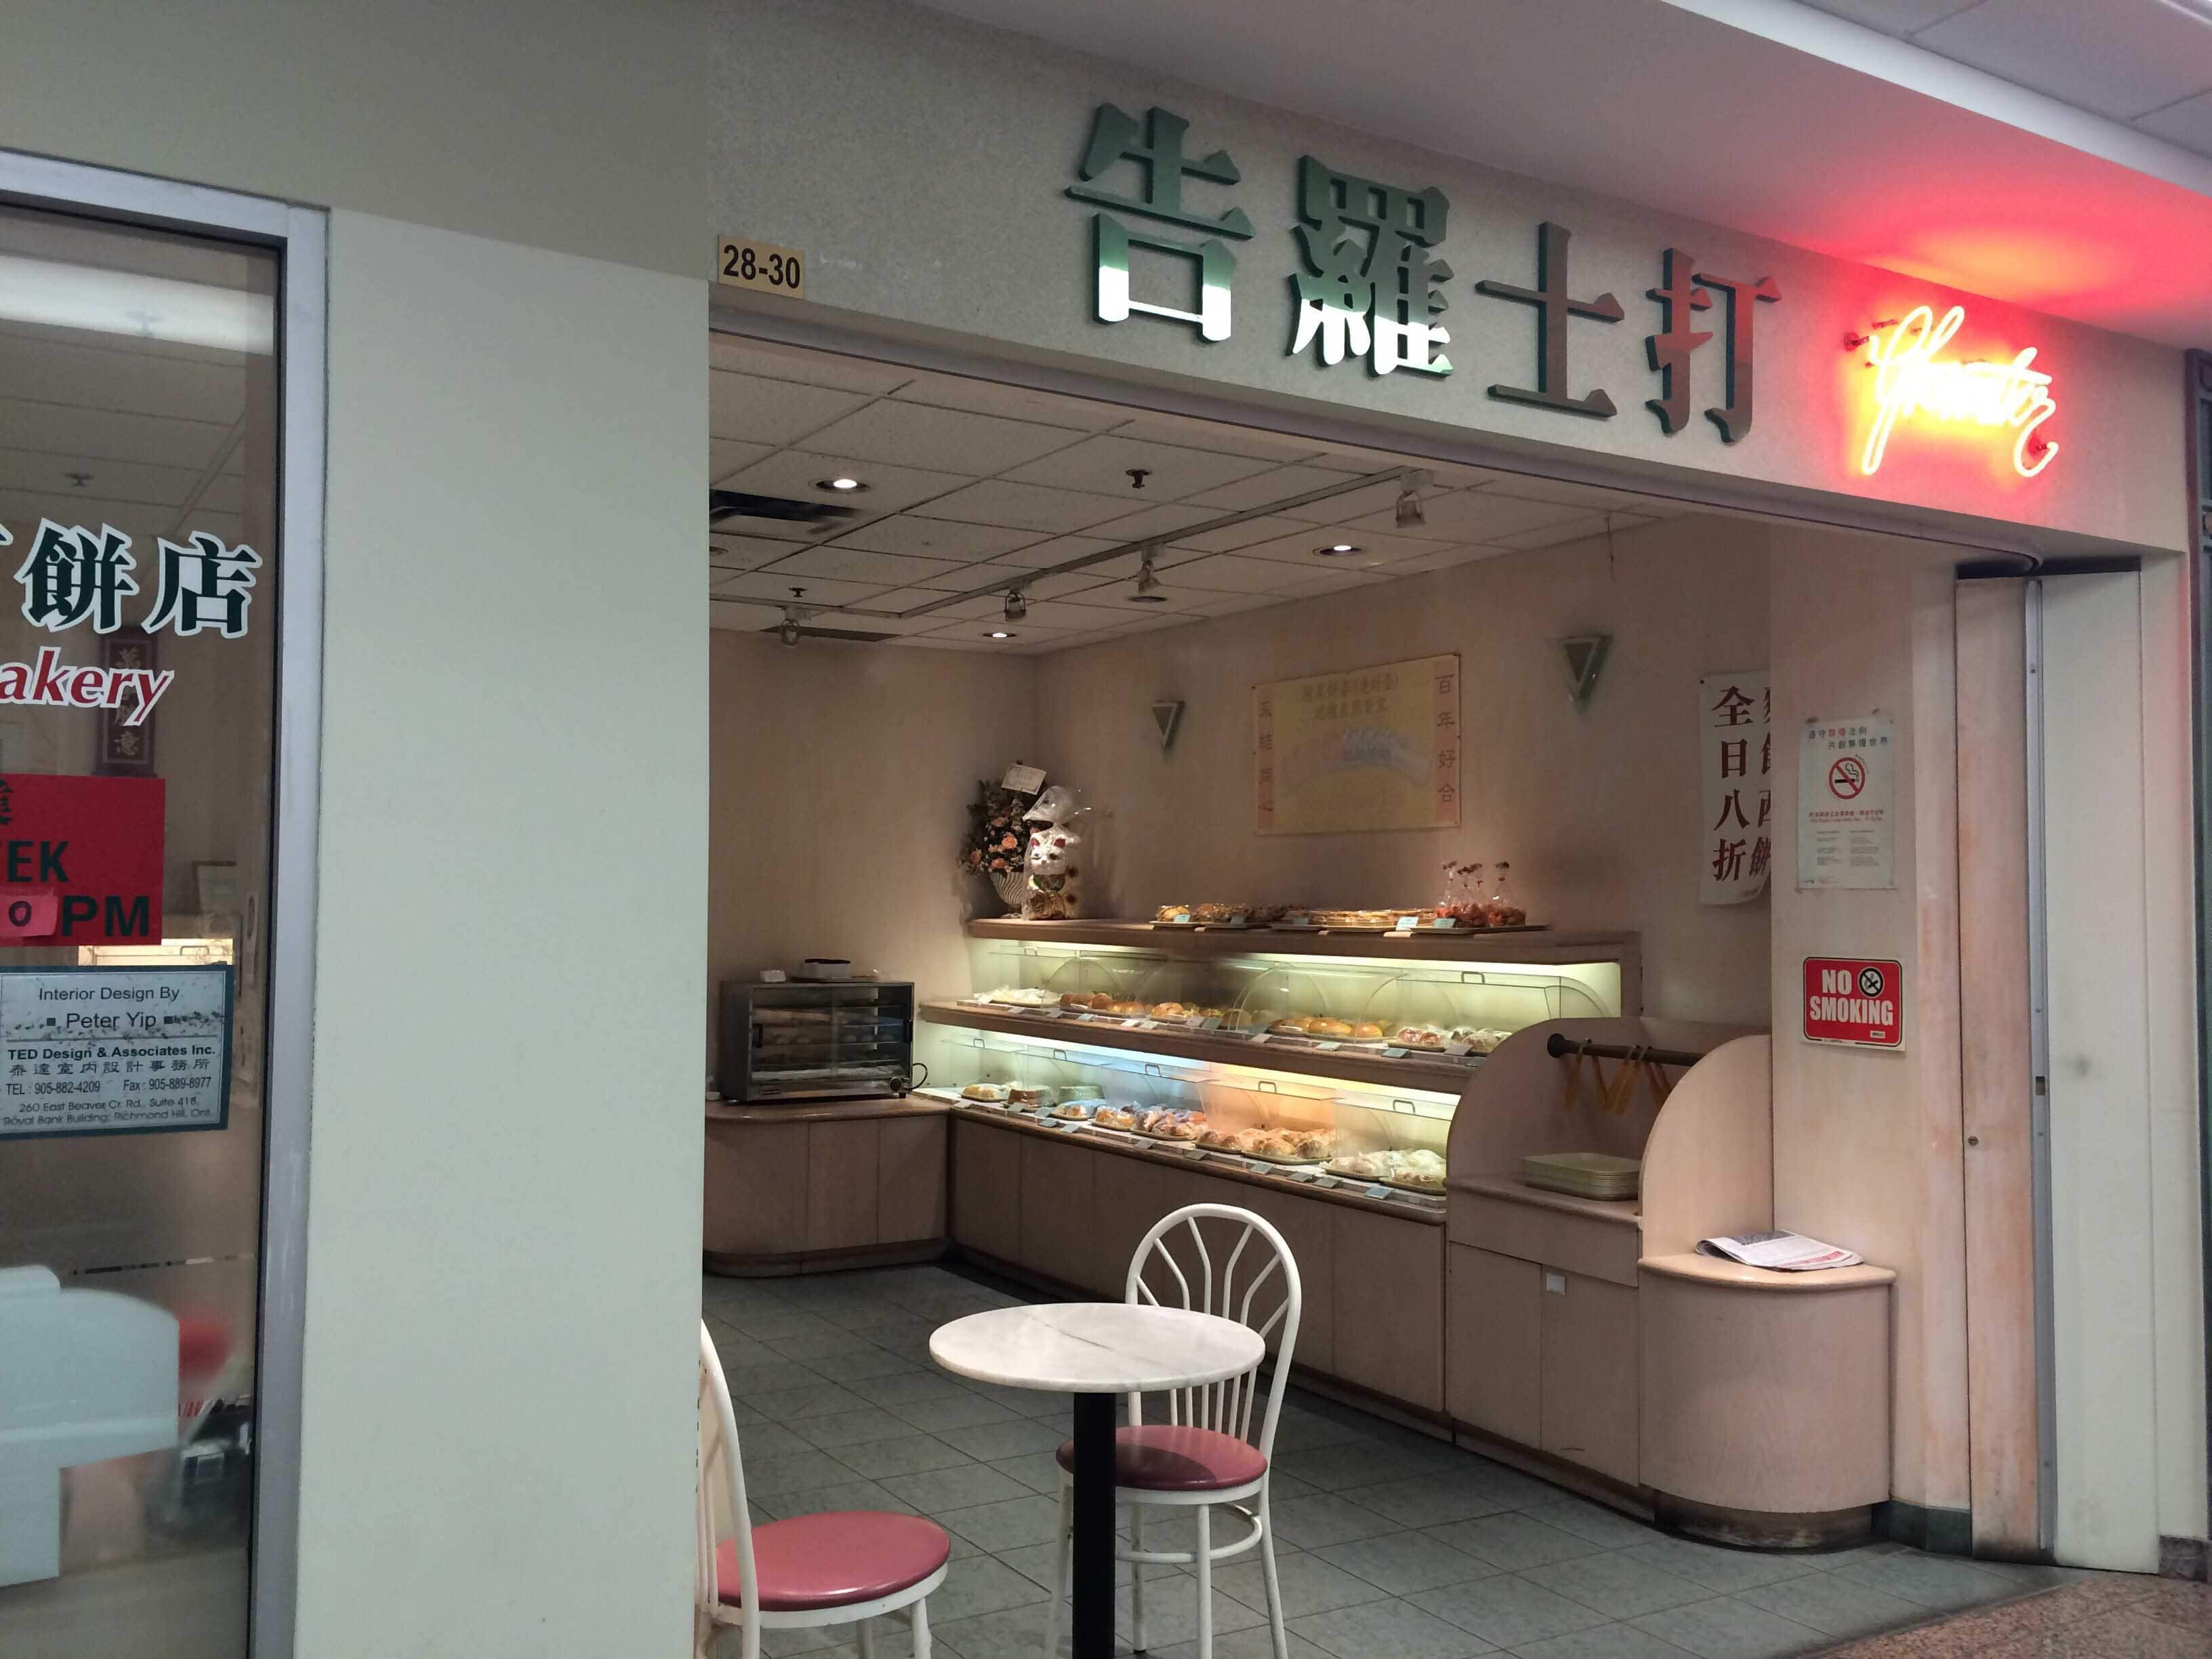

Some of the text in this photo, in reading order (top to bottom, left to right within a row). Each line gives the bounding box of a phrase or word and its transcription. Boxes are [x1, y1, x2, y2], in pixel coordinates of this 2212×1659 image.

[723, 245, 800, 289] 28-30
[0, 518, 262, 638] 餅店
[0, 647, 174, 726] akery
[1435, 674, 1456, 803] 百年好合
[1711, 685, 1755, 881] 全日八折
[0, 840, 70, 883] EK
[61, 895, 150, 937] PM
[39, 987, 180, 1002] Interior Design By
[1822, 969, 1852, 995] NO
[66, 1012, 157, 1030] Peter Yip
[1809, 996, 1893, 1026] SMOKING
[7, 1045, 216, 1061] TED Design & Associates Inc.
[19, 1103, 40, 1112] 260
[43, 1102, 65, 1111] East
[149, 1097, 174, 1107] Suite
